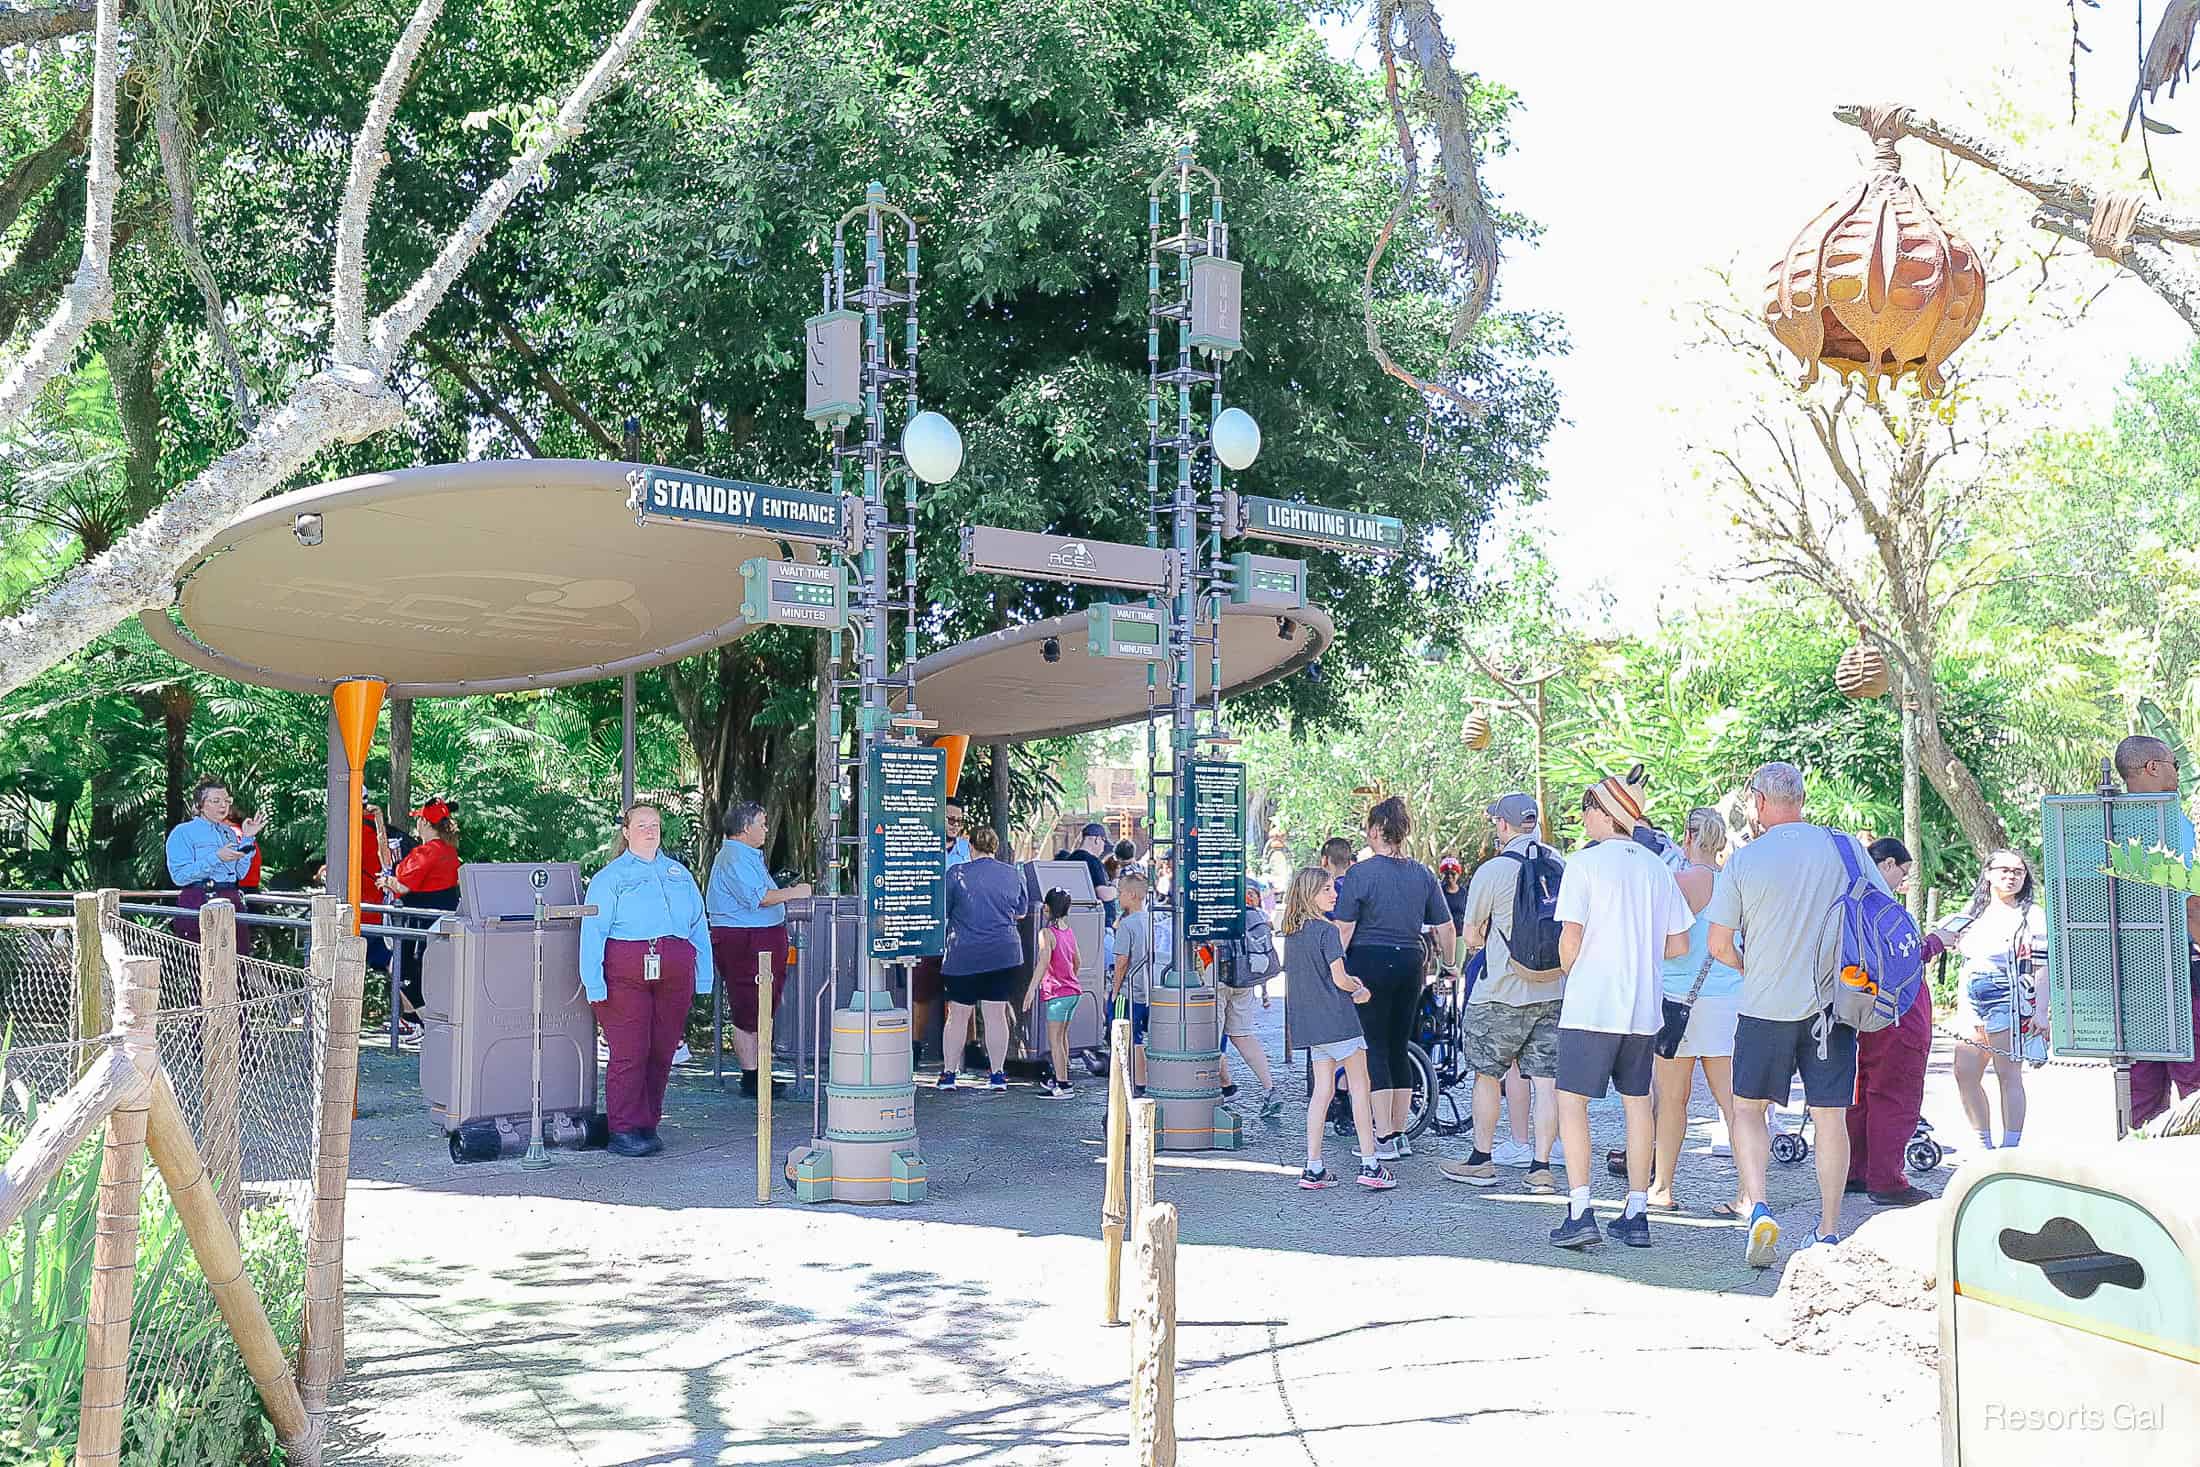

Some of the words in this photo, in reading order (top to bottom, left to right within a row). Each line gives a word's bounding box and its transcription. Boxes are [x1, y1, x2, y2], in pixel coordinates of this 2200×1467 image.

[653, 478, 757, 518] STANDBY
[762, 497, 836, 525] ENTRANCE
[1267, 504, 1345, 536] LIGHTNING
[1349, 517, 1384, 542] LANE
[1049, 553, 1087, 567] ACE
[779, 565, 805, 577] WAIT
[807, 567, 830, 580] TIME
[781, 607, 826, 620] MINUTES
[1117, 609, 1135, 620] WAIT
[1137, 611, 1155, 621] TIME
[1119, 644, 1153, 655] MINUTES
